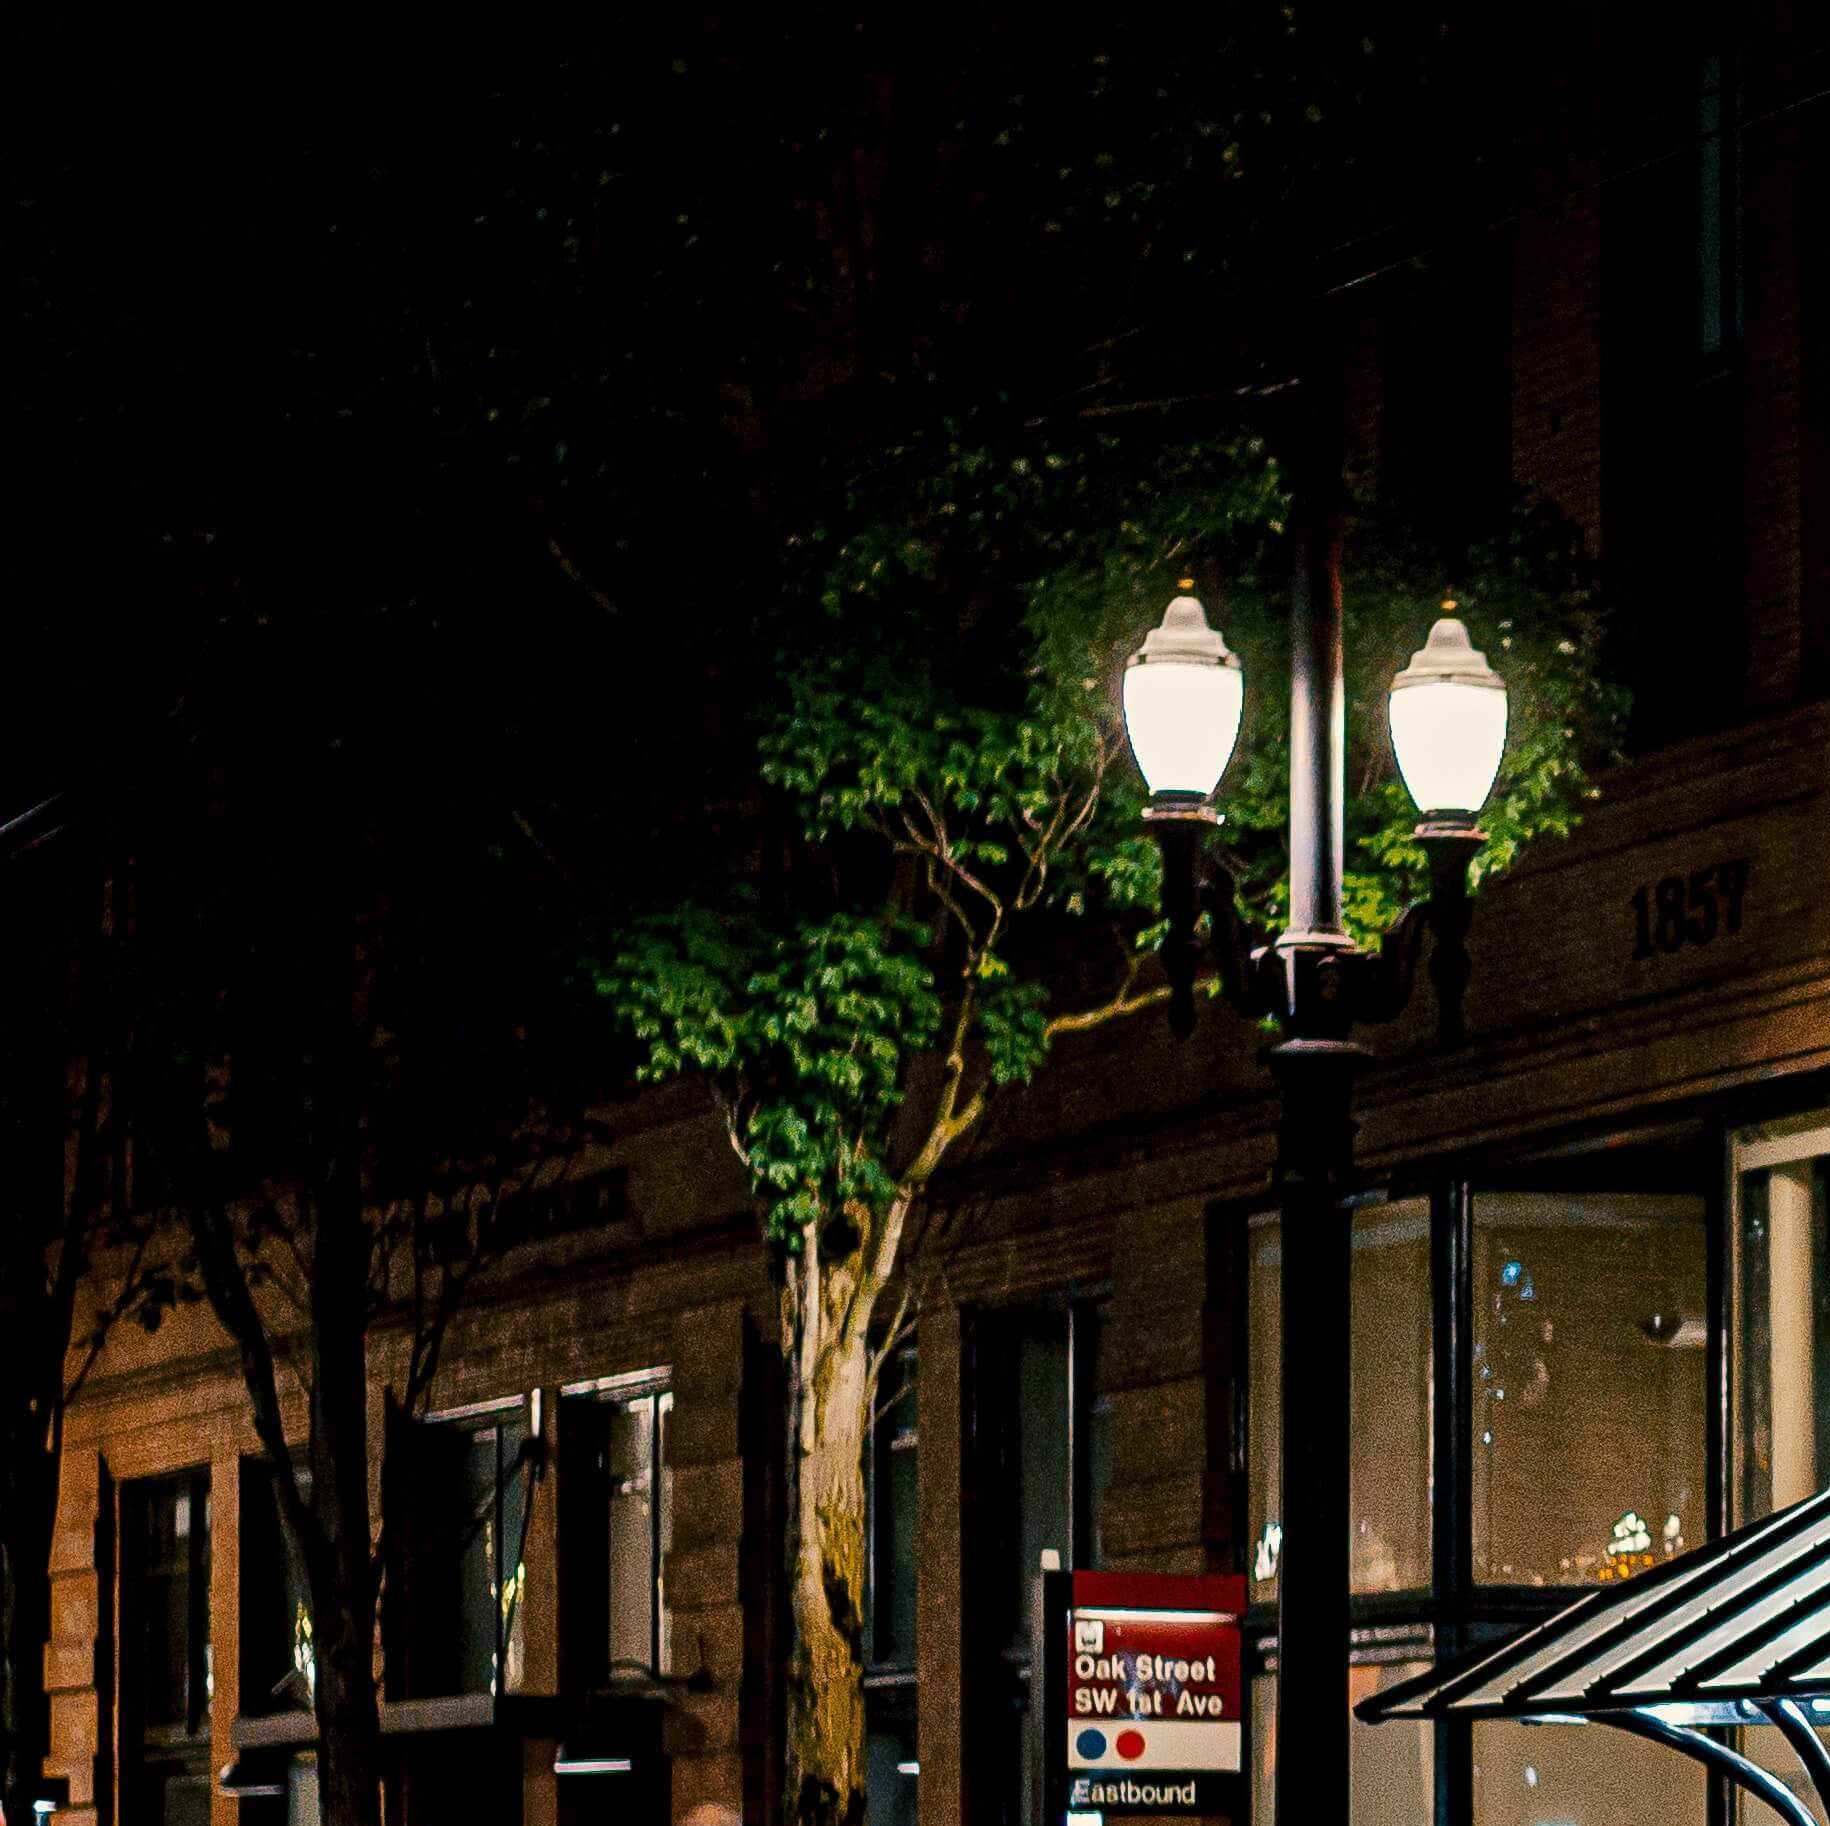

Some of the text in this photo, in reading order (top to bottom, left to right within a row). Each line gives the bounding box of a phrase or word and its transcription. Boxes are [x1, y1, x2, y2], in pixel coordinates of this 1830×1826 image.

[1075, 1653, 1216, 1683] Oak Street
[1075, 1687, 1118, 1714] SW
[1176, 1689, 1223, 1717] Ave
[1071, 1779, 1196, 1805] Eastbound
